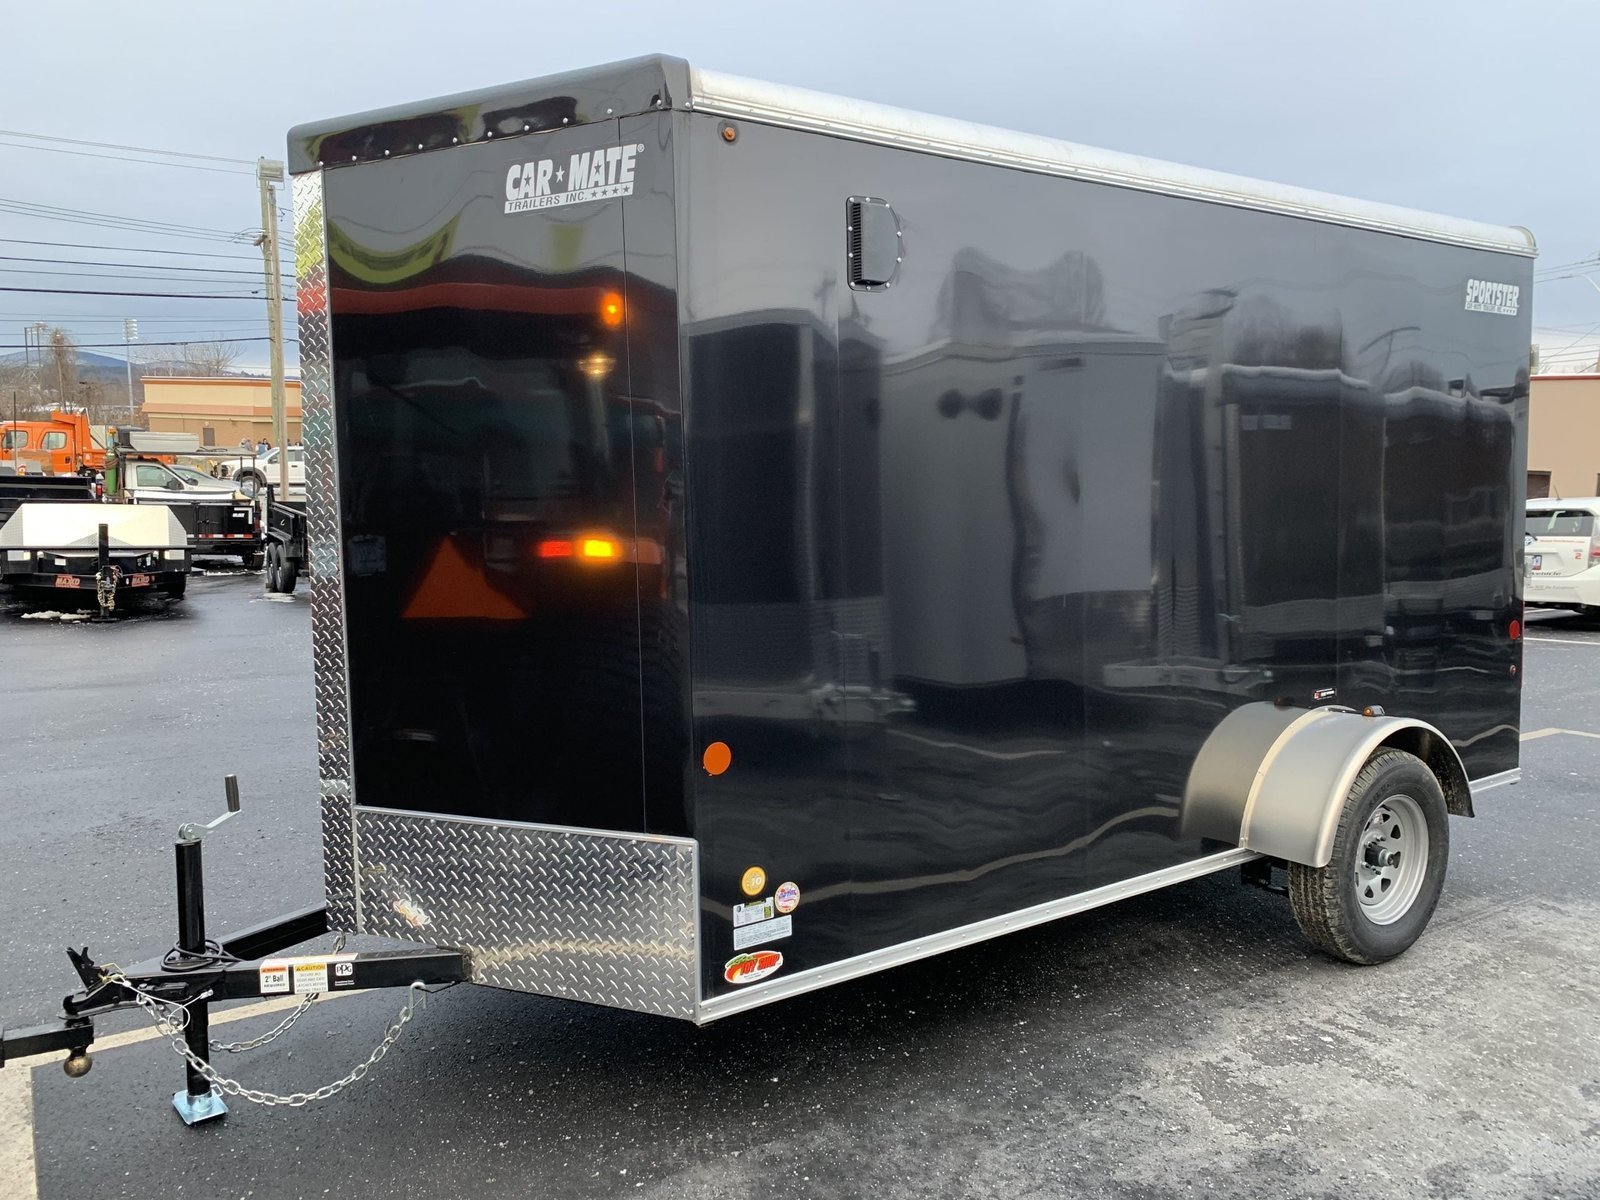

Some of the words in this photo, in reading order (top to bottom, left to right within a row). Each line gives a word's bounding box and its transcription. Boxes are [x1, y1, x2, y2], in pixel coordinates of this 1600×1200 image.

[505, 159, 553, 200] CAR
[507, 195, 560, 212] TRAILERS
[565, 191, 588, 203] INC.
[1466, 279, 1519, 307] SPORTSTER
[272, 974, 284, 983] Ball
